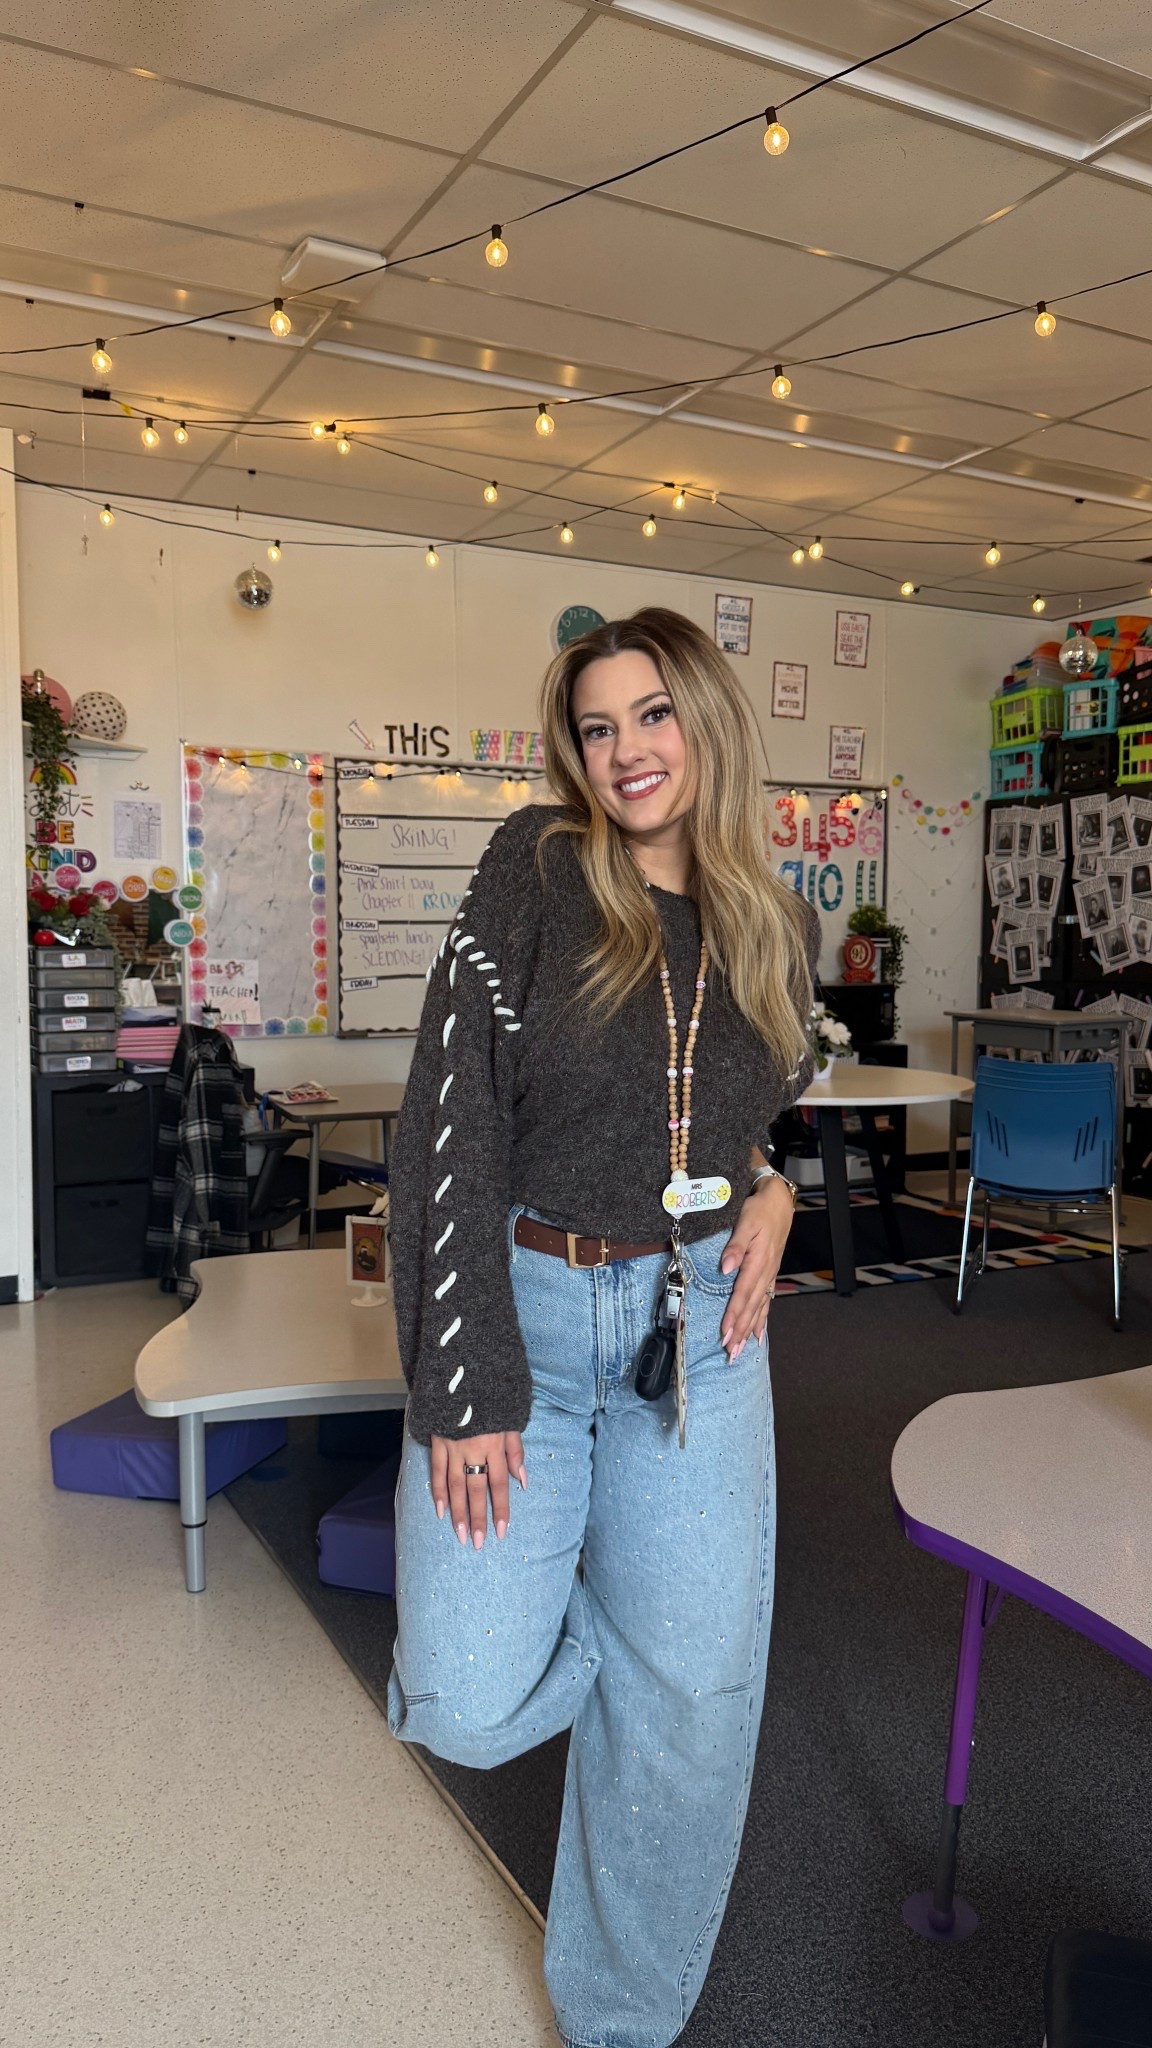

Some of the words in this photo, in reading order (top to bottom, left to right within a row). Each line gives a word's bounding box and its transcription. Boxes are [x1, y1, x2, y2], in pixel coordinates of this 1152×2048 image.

[579, 608, 589, 618] 12
[469, 729, 545, 765] WEE
[35, 819, 75, 844] BE
[345, 818, 375, 828] TUESDAY
[772, 796, 798, 848] 3
[803, 814, 831, 862] 4
[829, 798, 856, 848] 5
[858, 809, 883, 857] 6
[344, 863, 378, 874] WEDNESDAY
[807, 863, 843, 911] 10
[691, 1182, 702, 1190] MRS
[676, 1190, 717, 1208] ROBERTS
